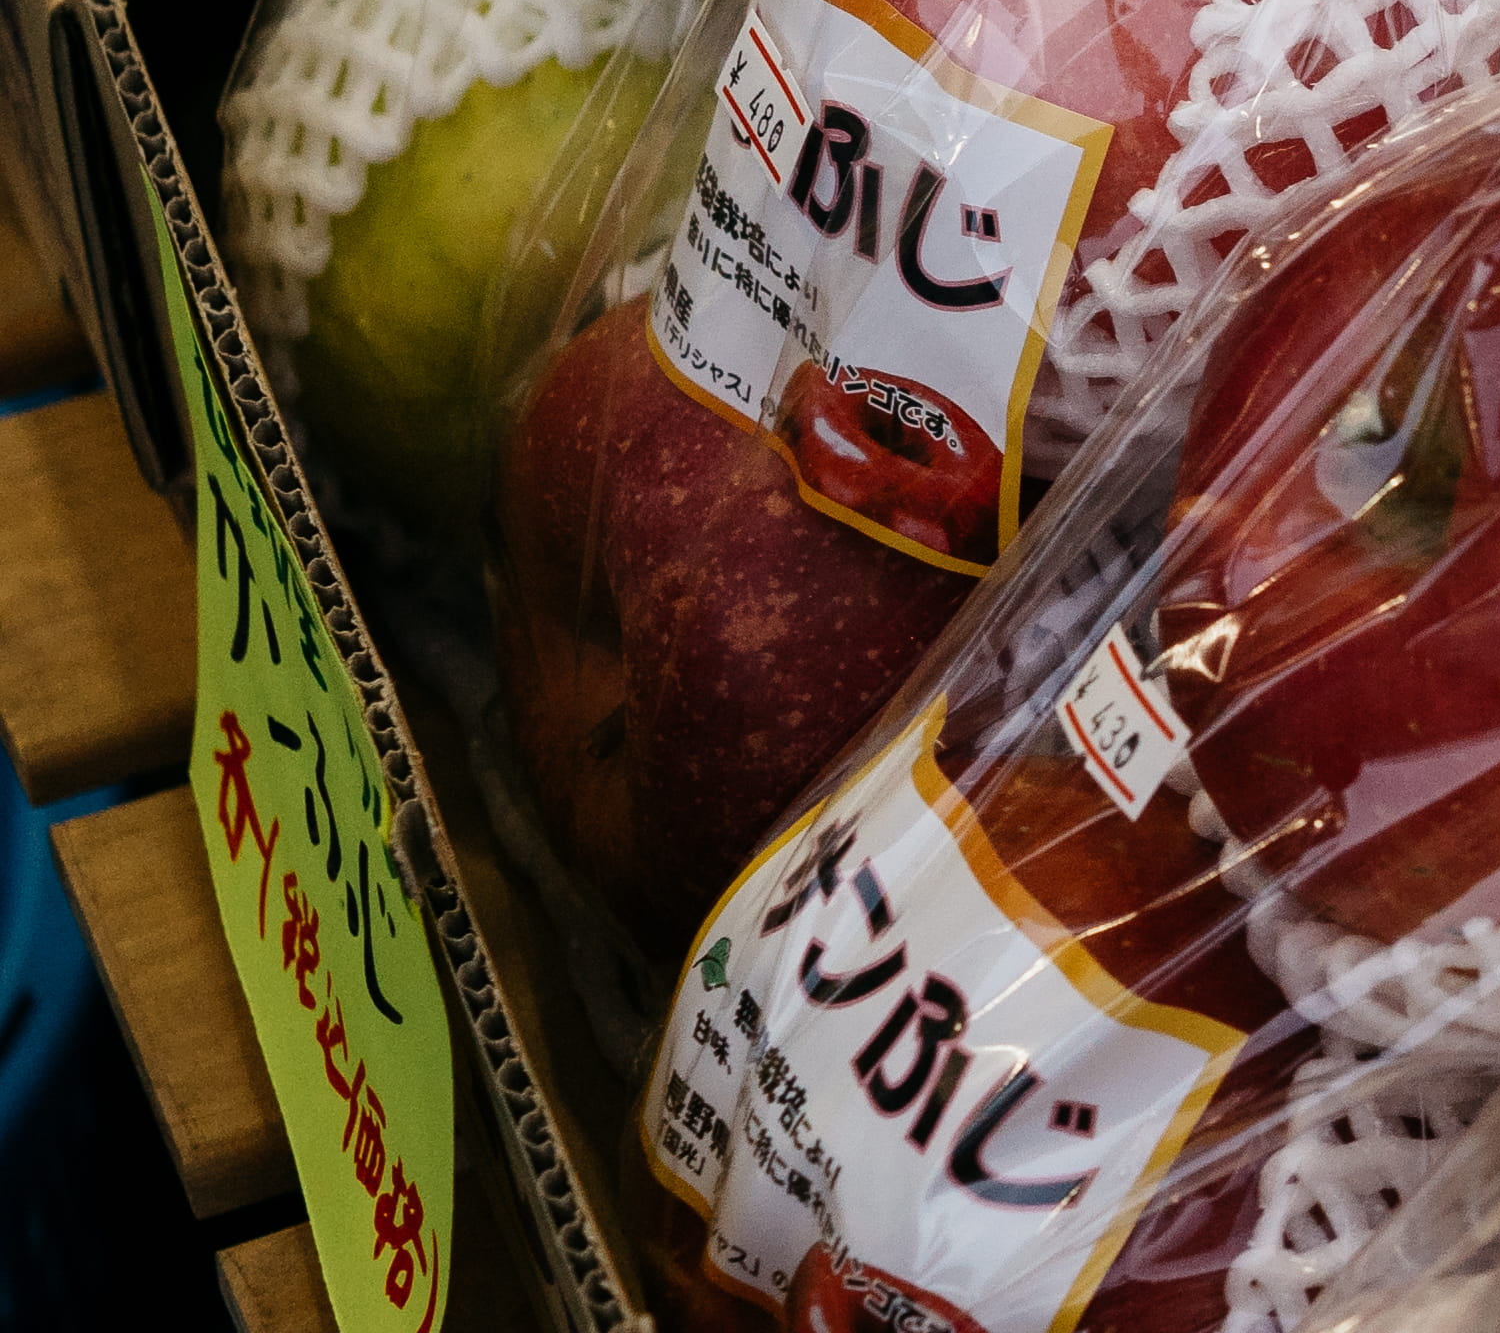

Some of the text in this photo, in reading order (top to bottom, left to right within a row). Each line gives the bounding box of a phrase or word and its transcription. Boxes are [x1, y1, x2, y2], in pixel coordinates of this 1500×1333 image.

[726, 49, 786, 155] ¥ 480
[731, 99, 1013, 313] ふじ
[207, 470, 403, 1025] サンふじ
[1090, 706, 1141, 771] 430
[733, 987, 842, 1190] 無栽培により
